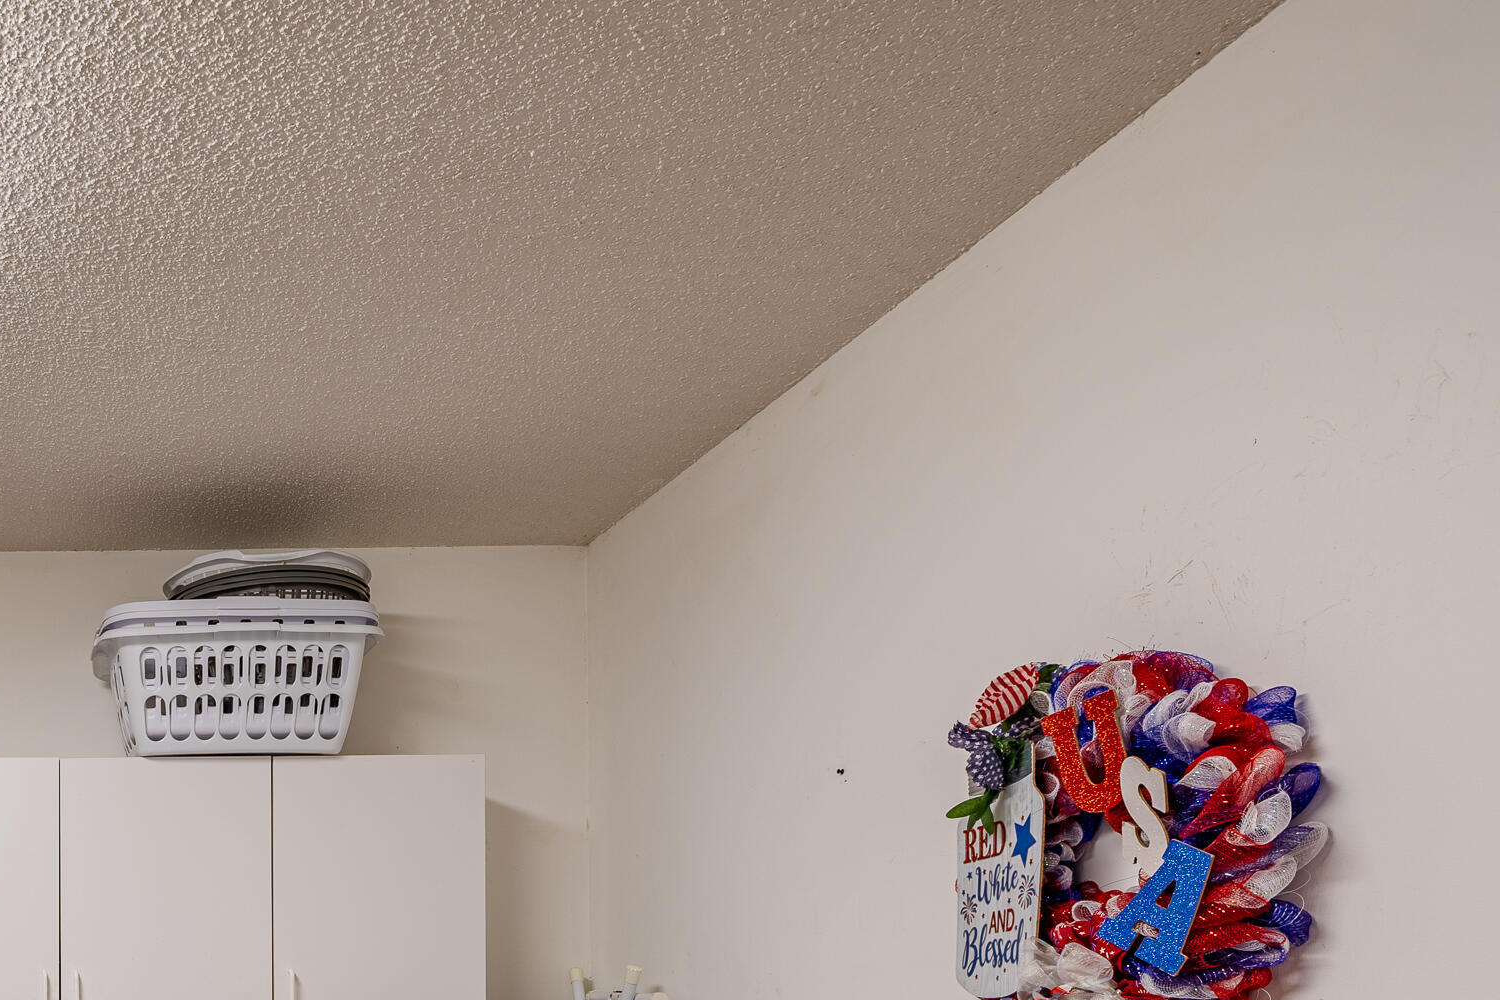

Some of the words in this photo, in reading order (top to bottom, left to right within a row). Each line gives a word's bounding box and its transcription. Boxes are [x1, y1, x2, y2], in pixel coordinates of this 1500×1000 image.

[963, 821, 1006, 864] RED
[976, 862, 1019, 905] White
[989, 908, 1015, 935] AND
[962, 918, 1024, 977] Blessed
